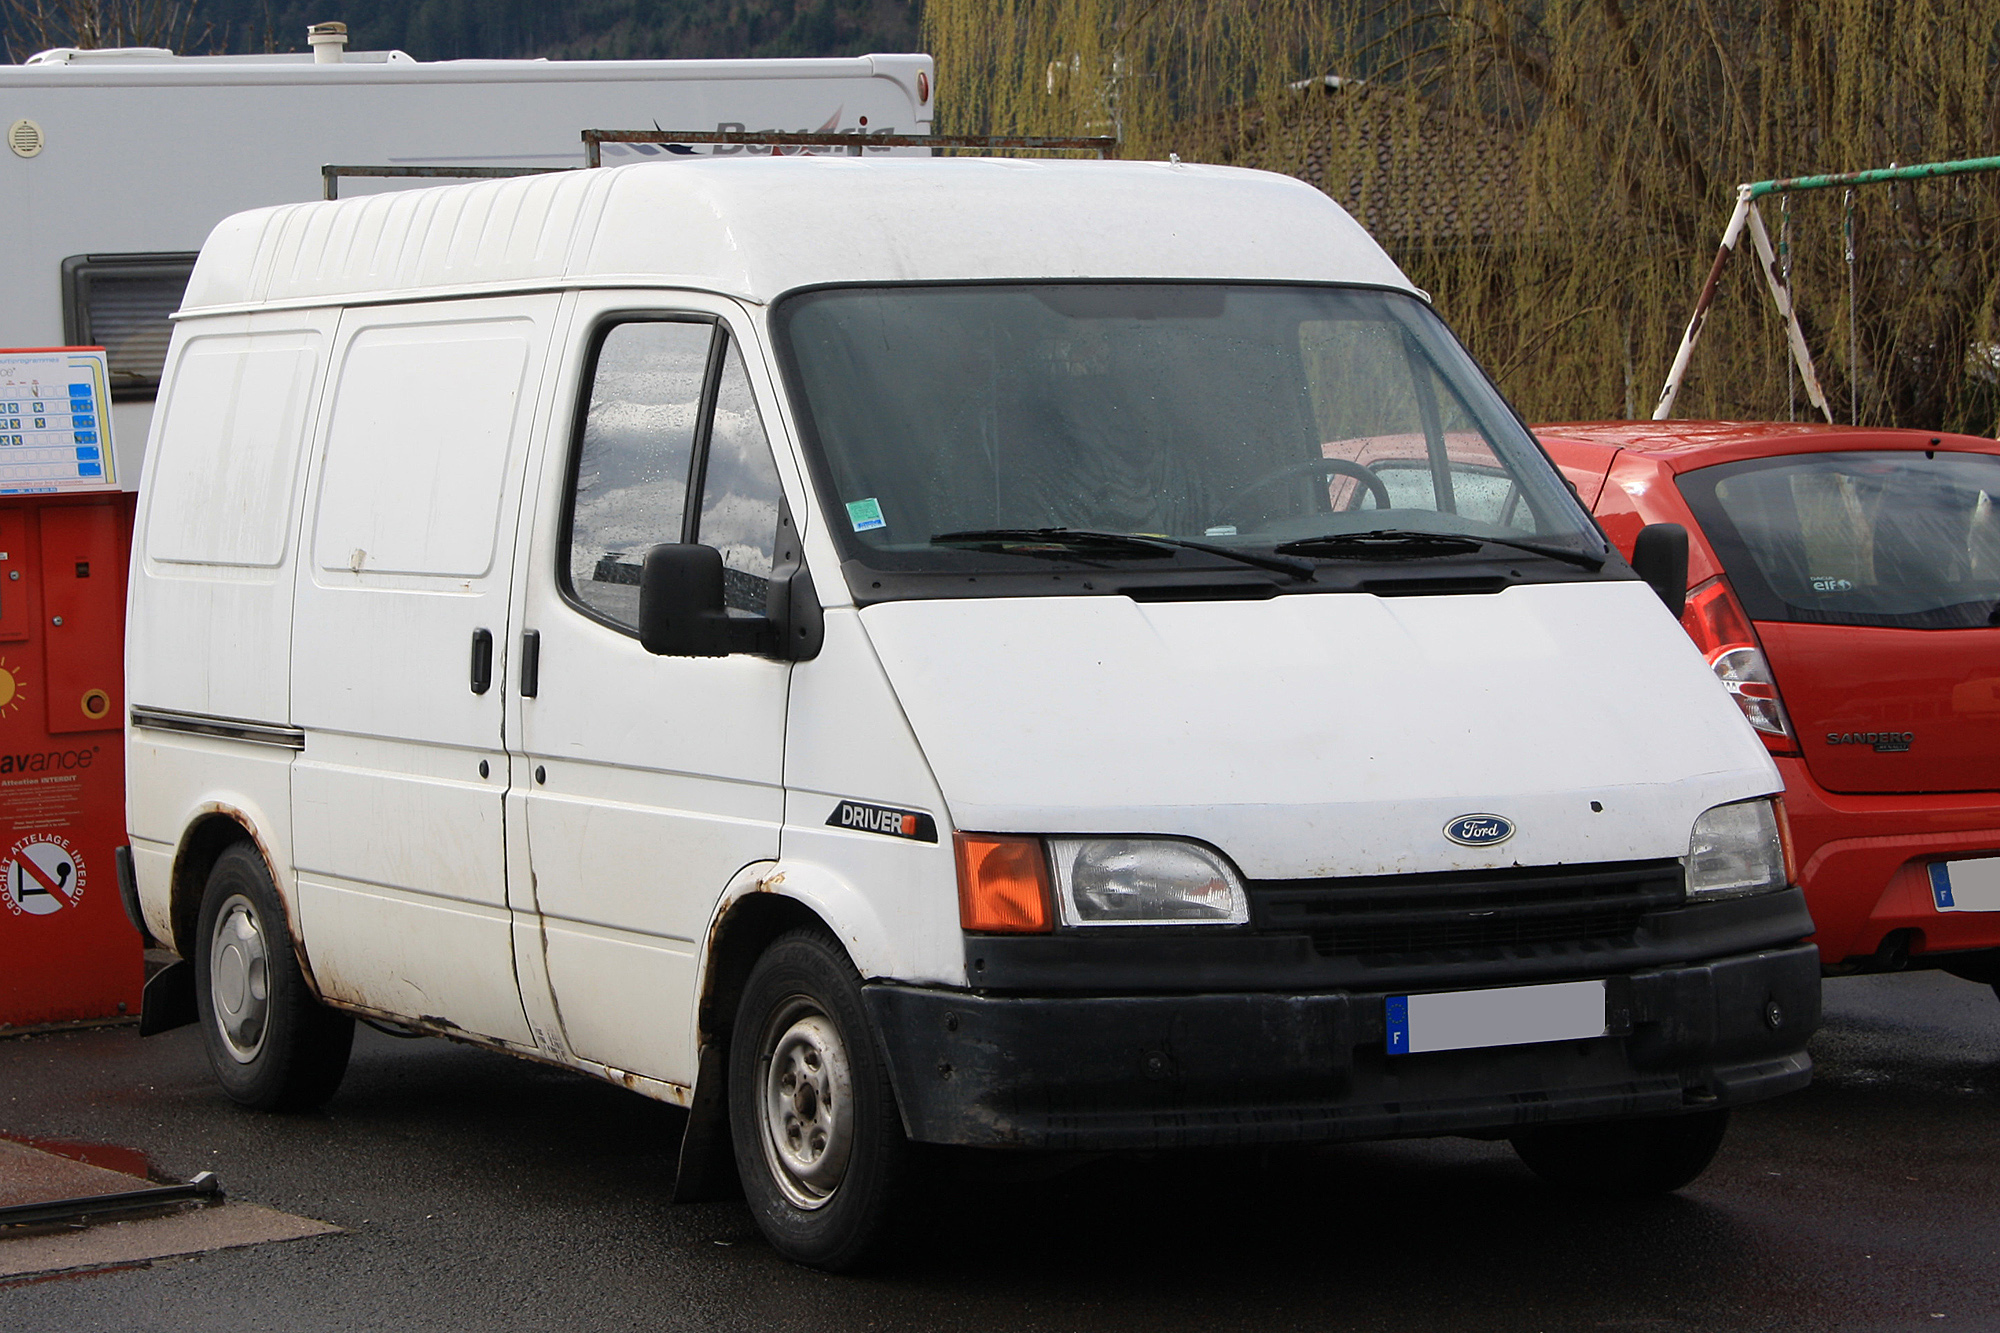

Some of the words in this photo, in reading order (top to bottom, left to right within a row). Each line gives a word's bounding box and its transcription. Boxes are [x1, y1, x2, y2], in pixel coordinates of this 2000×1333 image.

[1813, 580, 1837, 590] elf
[1826, 731, 1914, 744] SANDERO
[1, 778, 39, 787] Attention
[41, 775, 77, 783] INTERDIT
[841, 804, 903, 834] DRIVER
[1461, 820, 1499, 838] Ford
[0, 857, 22, 915] CROCHET
[11, 833, 70, 855] ATTELAGE
[71, 849, 87, 908] INTERDIT
[1940, 890, 1947, 901] F
[1393, 1031, 1401, 1045] F
